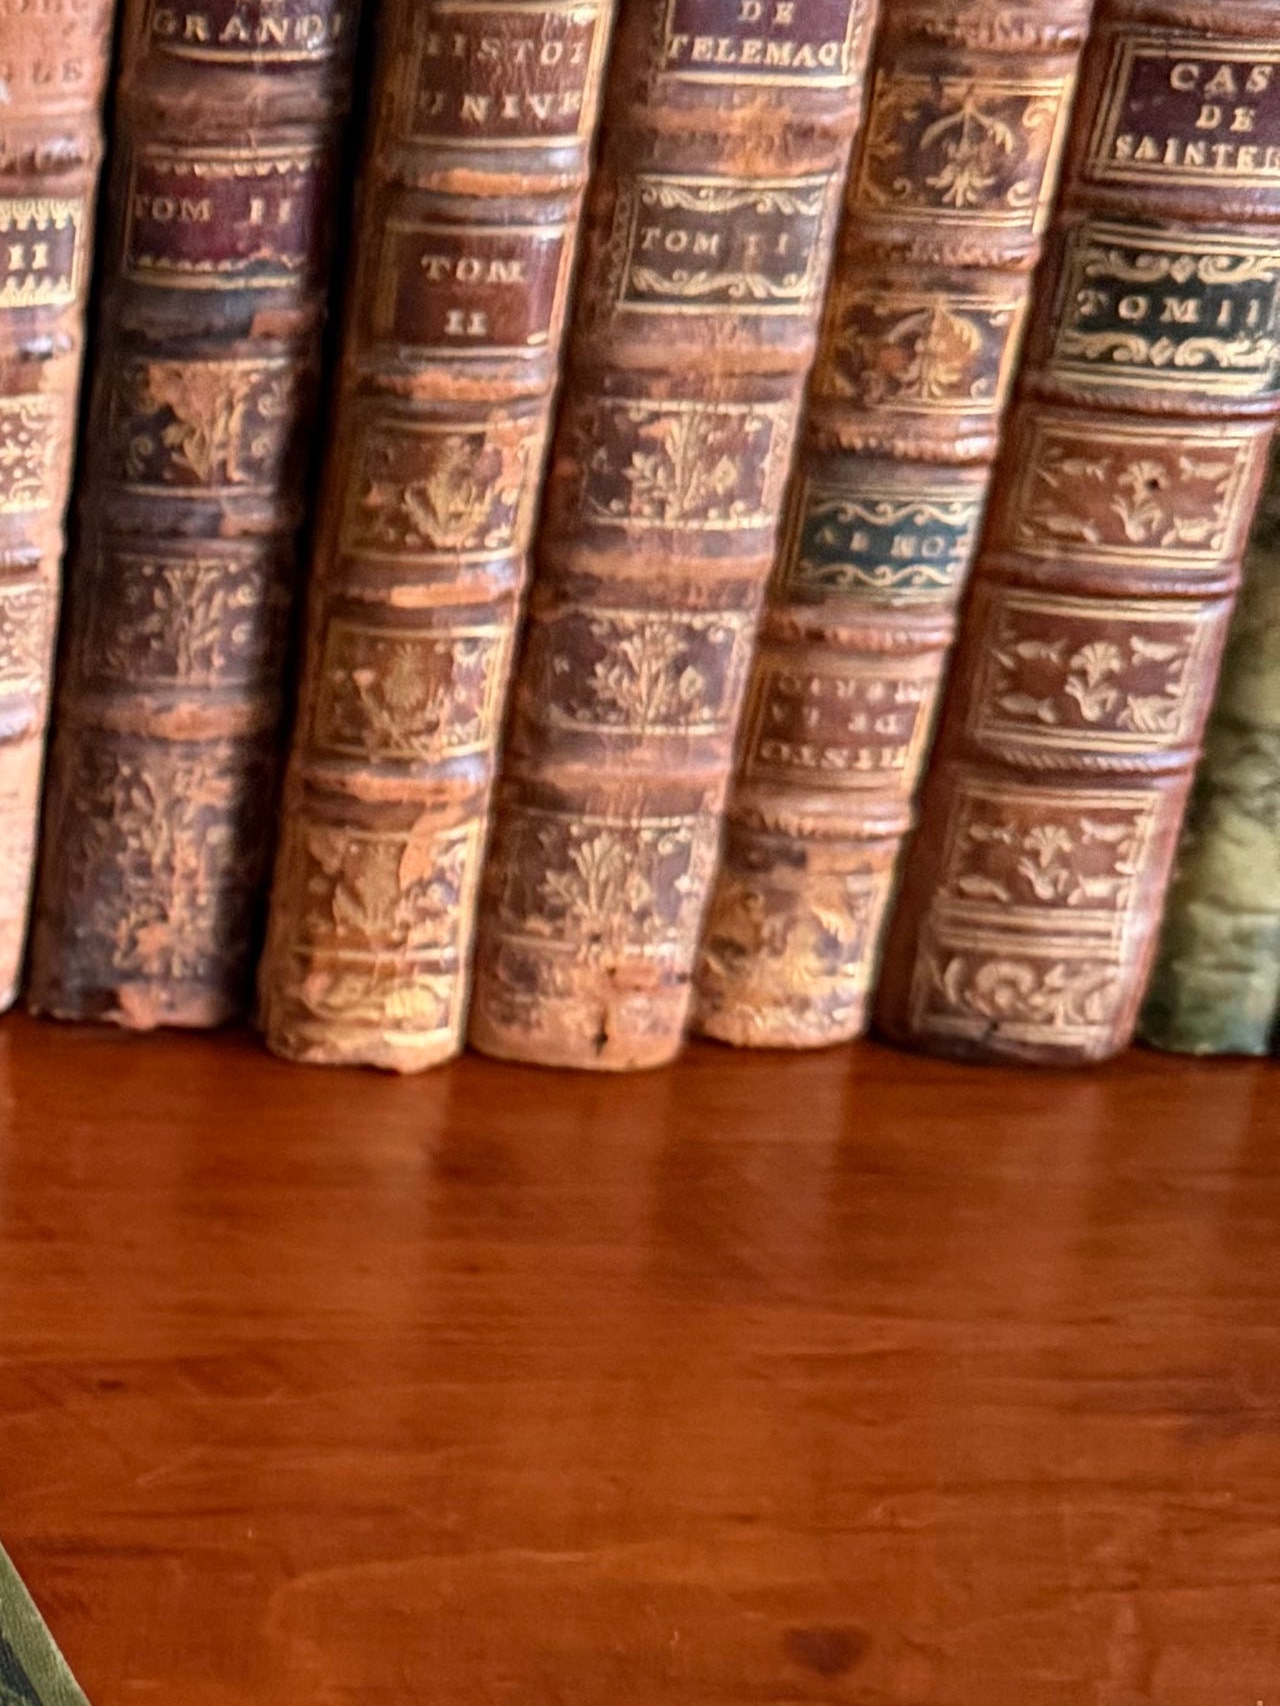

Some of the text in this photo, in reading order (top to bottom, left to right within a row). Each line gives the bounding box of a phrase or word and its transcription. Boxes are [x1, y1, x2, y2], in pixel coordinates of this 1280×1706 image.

[738, 0, 797, 25] DE
[1170, 63, 1274, 96] CAS
[1195, 105, 1256, 133] DE
[641, 227, 720, 256] TOM
[8, 243, 48, 269] II
[421, 255, 527, 283] TOM
[1077, 290, 1202, 324] TOM
[444, 309, 489, 336] II
